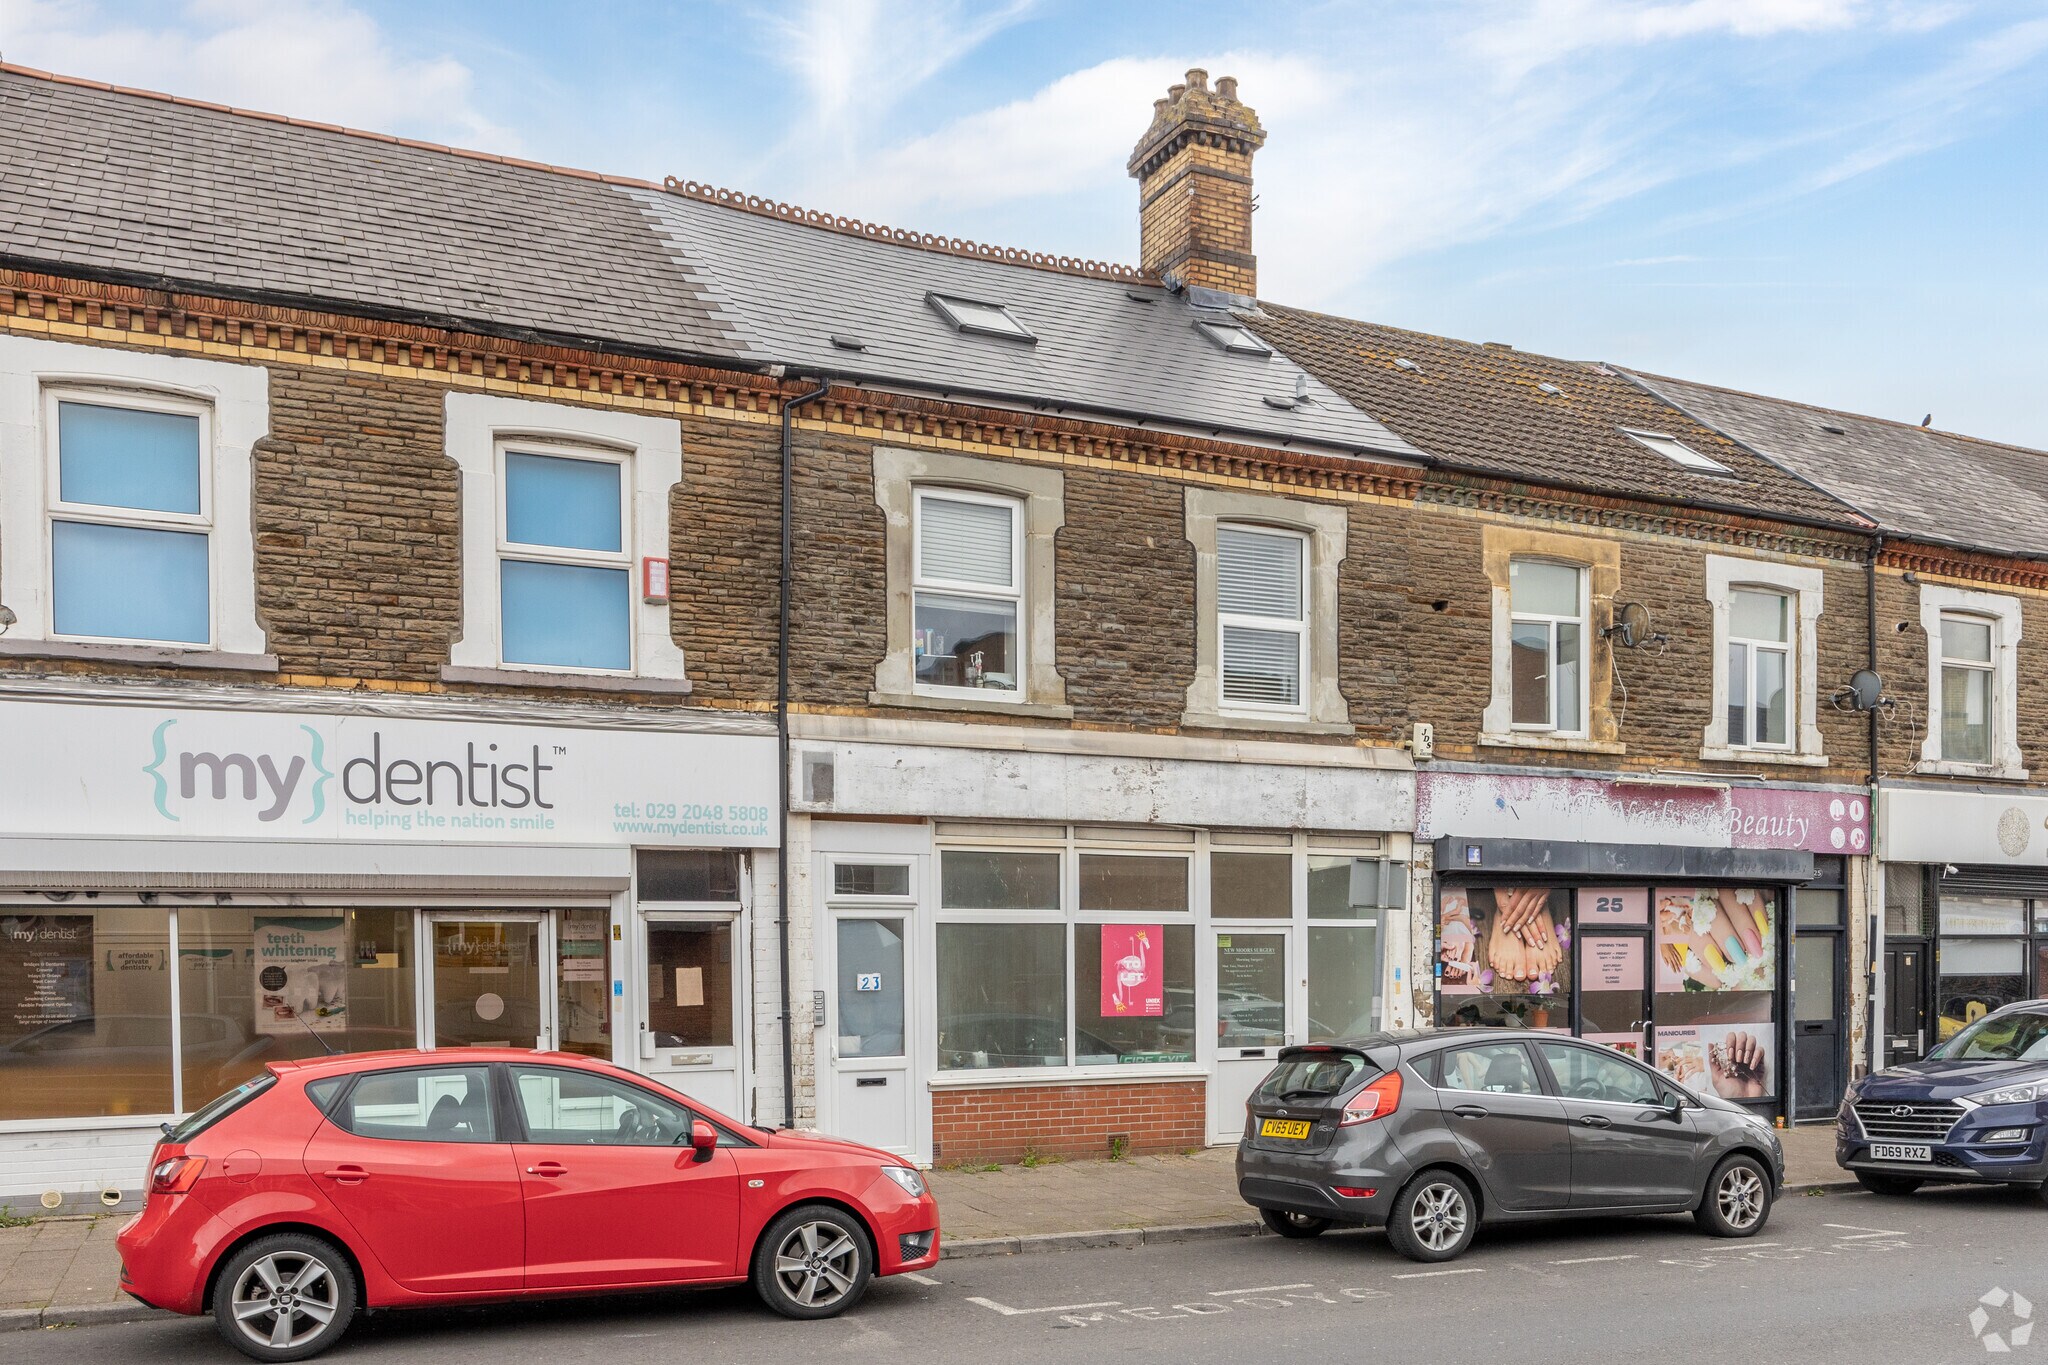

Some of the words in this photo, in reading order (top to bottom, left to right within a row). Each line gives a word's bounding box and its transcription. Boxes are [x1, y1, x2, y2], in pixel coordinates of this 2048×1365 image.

[342, 731, 554, 810] dentist
[345, 808, 412, 831] helping
[416, 811, 446, 828] the
[450, 812, 506, 829] nation
[509, 813, 555, 830] smile
[613, 802, 641, 819] tel:
[645, 802, 677, 819] 029
[682, 804, 723, 821] 2048
[728, 805, 769, 822] 5808
[613, 820, 769, 837] www.mydentist.co.uk
[1727, 806, 1810, 847] Beauty
[1596, 897, 1623, 912] 25
[40, 927, 77, 939] dentist
[267, 932, 305, 944] teeth
[261, 944, 337, 959] whitening
[1123, 960, 1141, 969] TO
[861, 976, 880, 990] 23
[1120, 972, 1144, 982] LET
[1657, 1029, 1696, 1037] MANICURES
[1265, 1120, 1289, 1134] CV65
[1288, 1122, 1307, 1136] UEX
[1874, 1145, 1902, 1158] FD69
[1904, 1147, 1927, 1159] RXZ
